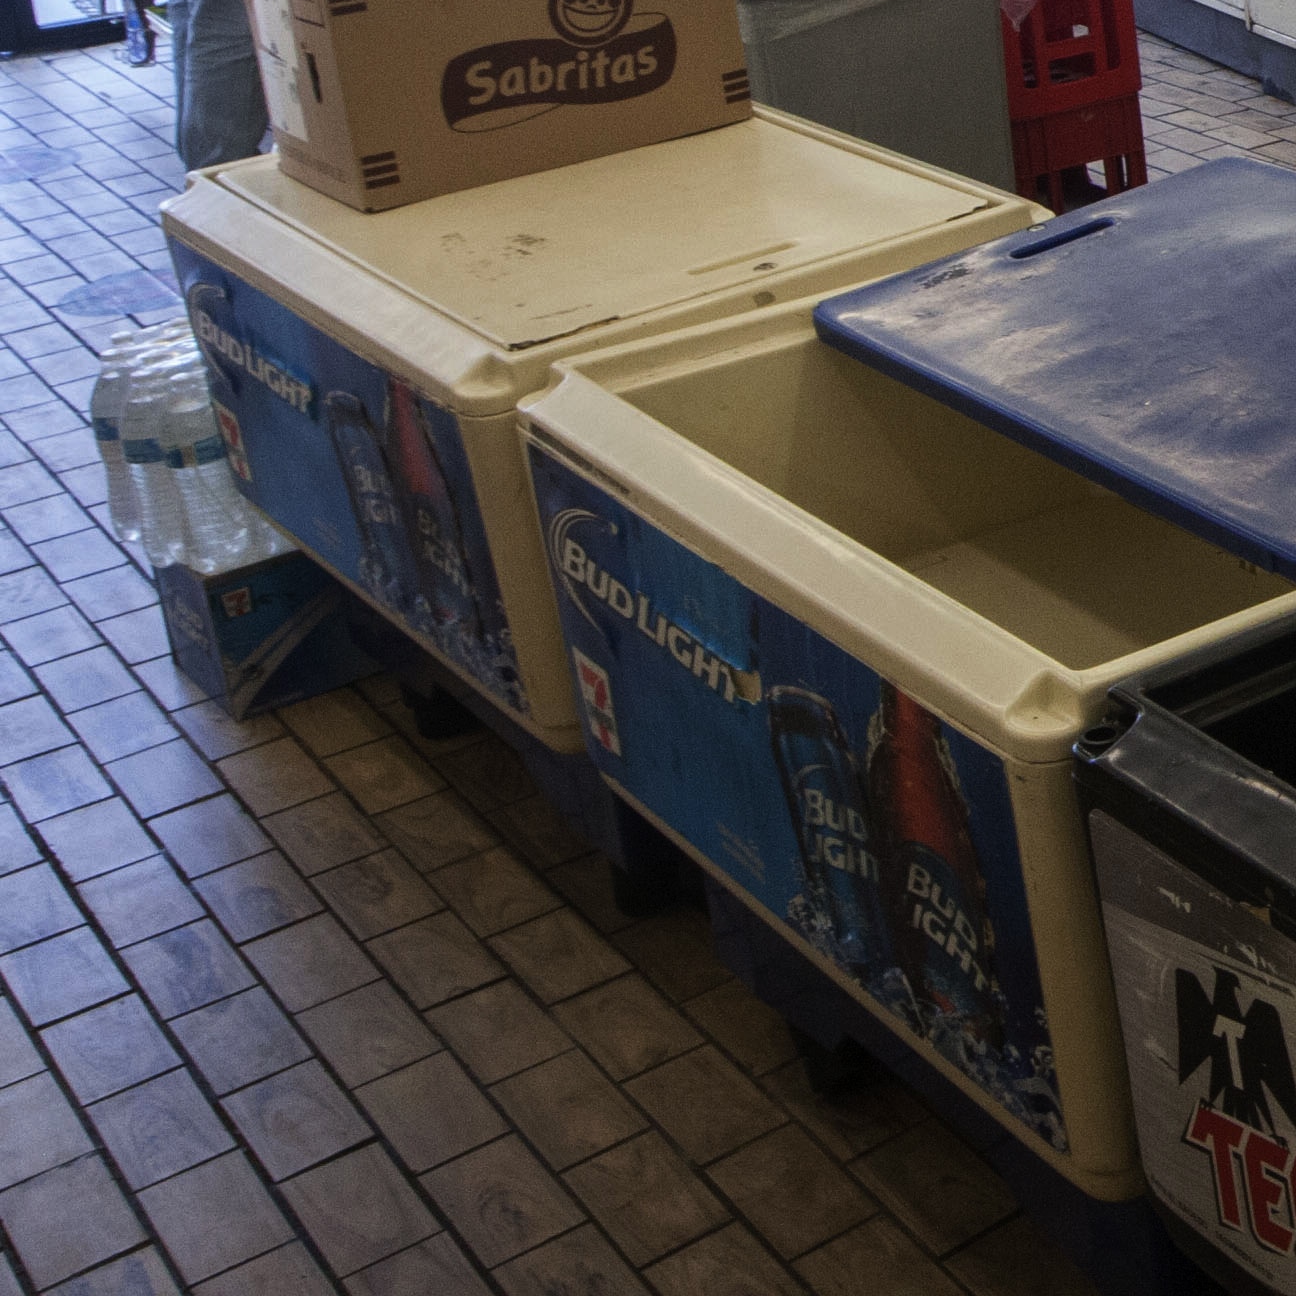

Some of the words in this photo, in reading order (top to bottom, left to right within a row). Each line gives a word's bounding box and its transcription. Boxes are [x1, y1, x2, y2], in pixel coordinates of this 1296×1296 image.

[464, 42, 660, 106] Sabritas
[197, 308, 245, 366] BUD
[559, 537, 633, 621] BUD
[803, 788, 868, 840] BUD
[908, 862, 979, 952] BUD
